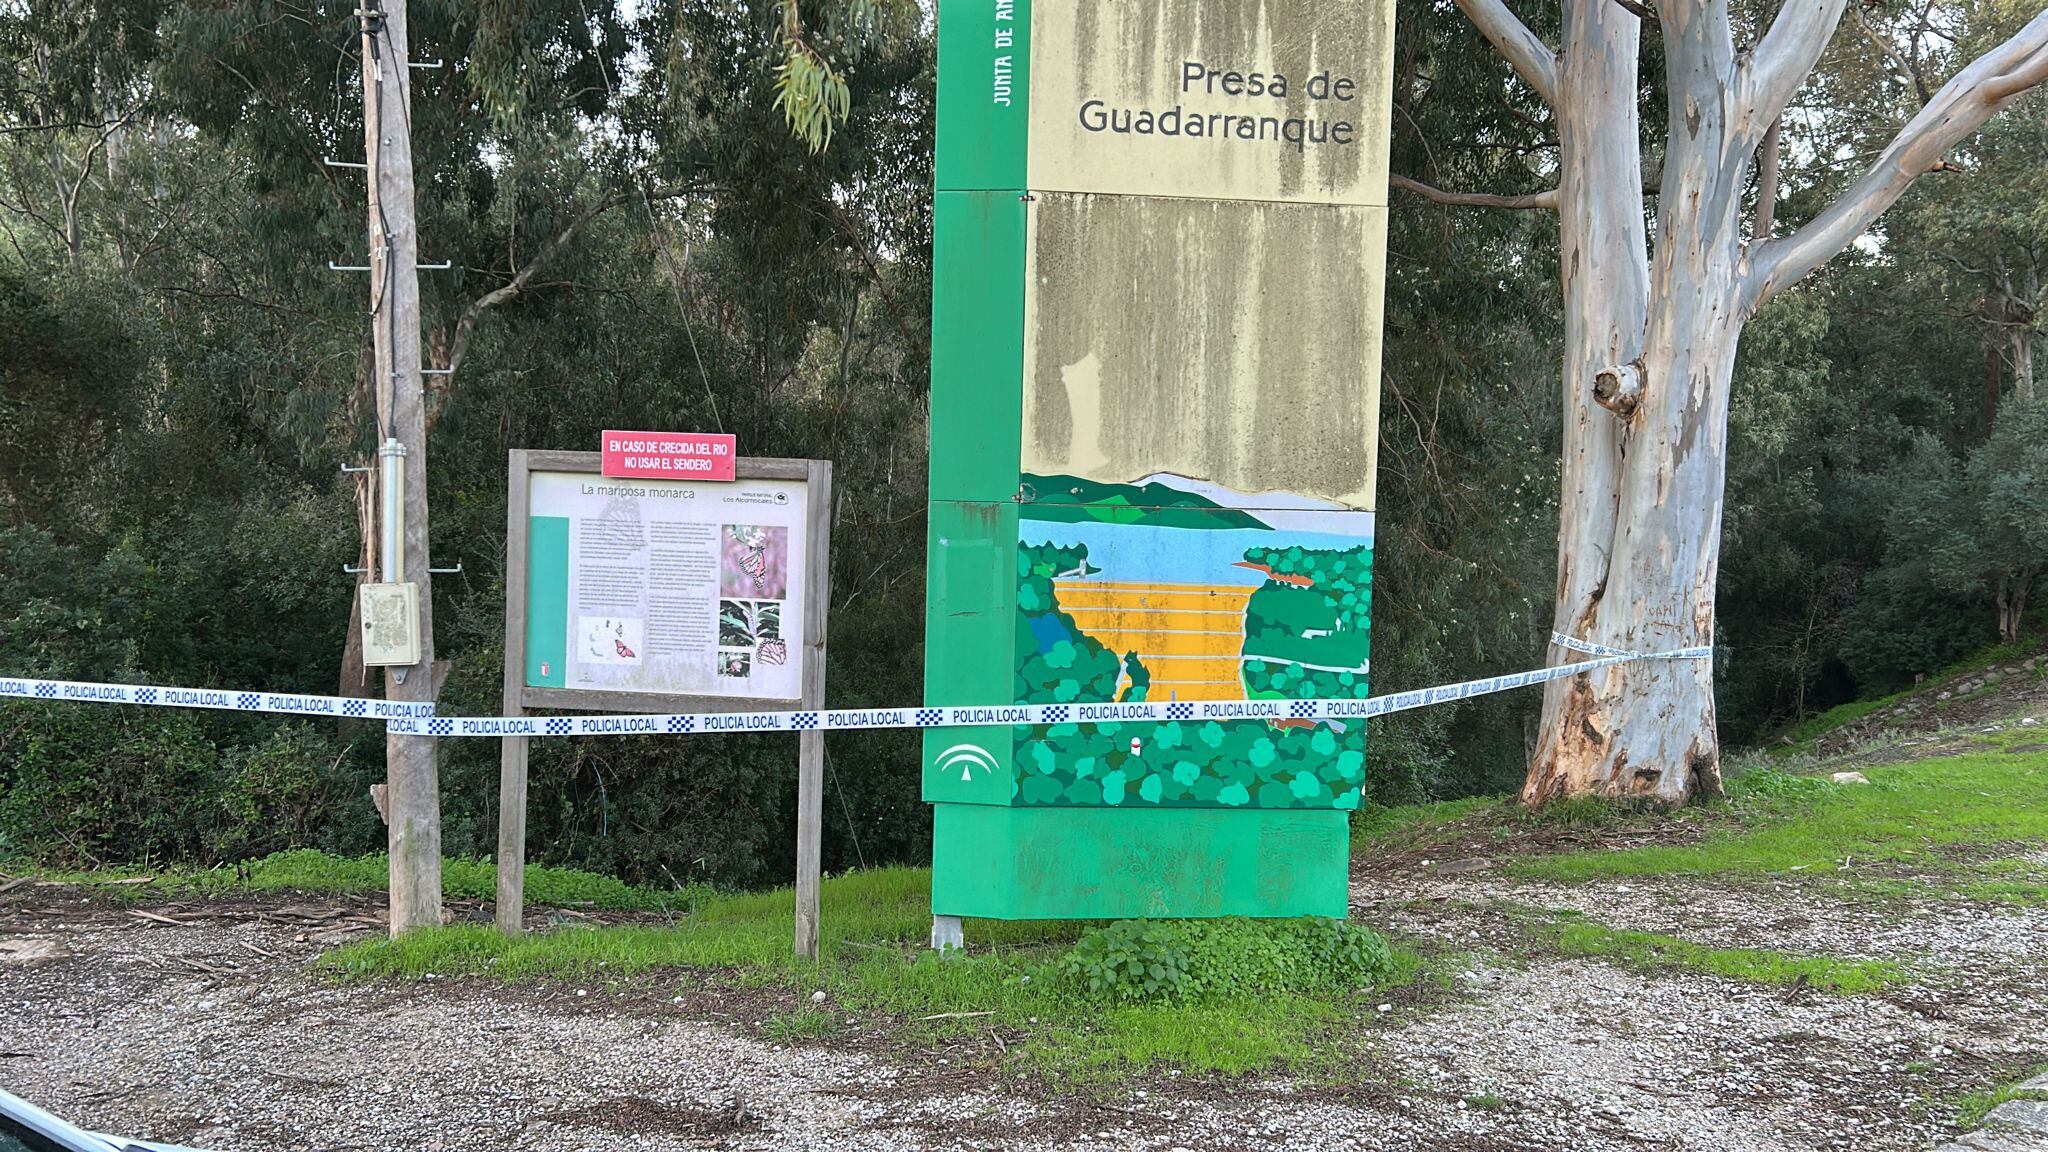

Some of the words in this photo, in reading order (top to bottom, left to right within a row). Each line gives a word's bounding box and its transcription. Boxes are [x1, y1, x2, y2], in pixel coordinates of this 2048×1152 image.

[995, 28, 1013, 49] DE
[994, 55, 1012, 107] JUNTA
[1182, 61, 1287, 98] Presa
[1306, 70, 1356, 101] de
[1079, 100, 1354, 153] Guadarranque
[610, 440, 621, 452] EN
[622, 441, 646, 453] CASO
[646, 442, 658, 453] DE
[659, 442, 695, 454] CRECIDA
[695, 444, 711, 455] DEL
[713, 444, 728, 456] RIO
[624, 456, 637, 468] NO
[638, 457, 661, 469] USAR
[662, 458, 673, 470] EL
[673, 459, 712, 471] SENDERO
[581, 483, 594, 495] La
[597, 486, 646, 498] mariposa
[649, 488, 695, 499] monarca
[0, 681, 27, 694] LOCAL
[64, 685, 97, 699] POLICIA
[98, 687, 127, 700] LOCAL
[165, 691, 199, 705] POLICIA
[200, 693, 229, 706] LOCAL
[268, 696, 303, 711] POLICIA
[304, 698, 334, 713] LOCAL
[375, 703, 412, 717] POLICIA
[953, 709, 994, 723] POLICIA
[996, 708, 1031, 722] LOCAL
[1079, 706, 1120, 720] POLICIA
[1122, 705, 1156, 719] LOCAL
[1203, 703, 1244, 717] POLICIA
[1246, 702, 1280, 716] LOCAL
[1327, 702, 1366, 715] POLICIA
[389, 719, 418, 732] LOCAL
[582, 719, 622, 732] POLICIA
[623, 718, 658, 732] LOCAL
[704, 716, 744, 730] POLICIA
[746, 715, 781, 729] LOCAL
[828, 713, 868, 726] POLICIA
[871, 711, 906, 725] LOCAL
[462, 720, 501, 734] POLICIA
[502, 720, 536, 733] LOCAL
